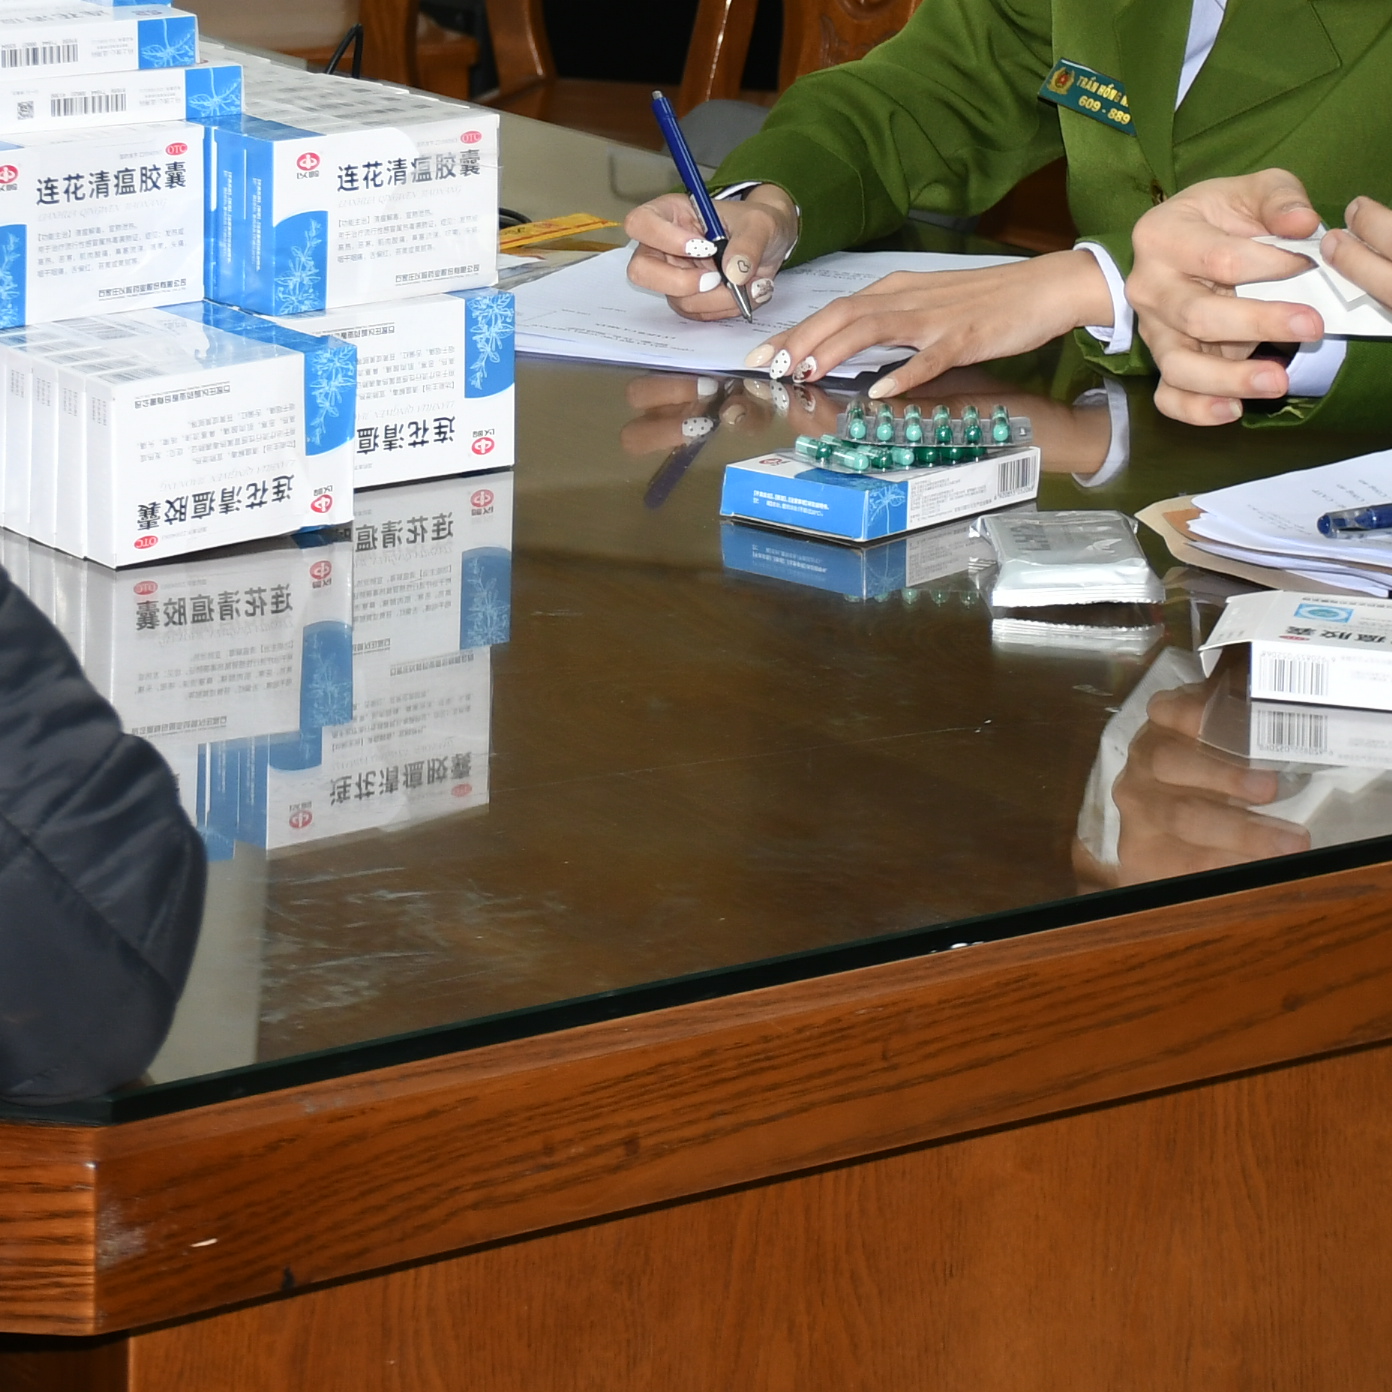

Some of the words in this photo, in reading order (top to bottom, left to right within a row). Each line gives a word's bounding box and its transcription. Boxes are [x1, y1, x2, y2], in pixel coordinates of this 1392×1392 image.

[1078, 96, 1101, 113] 609
[1107, 108, 1132, 125] 889
[167, 144, 187, 154] OTC
[462, 132, 481, 143] OTC
[36, 161, 187, 206] 连花清瘟胶囊
[337, 149, 481, 192] 连花清瘟胶囊
[137, 474, 296, 531] 连花清瘟胶囊
[136, 536, 158, 549] OTC
